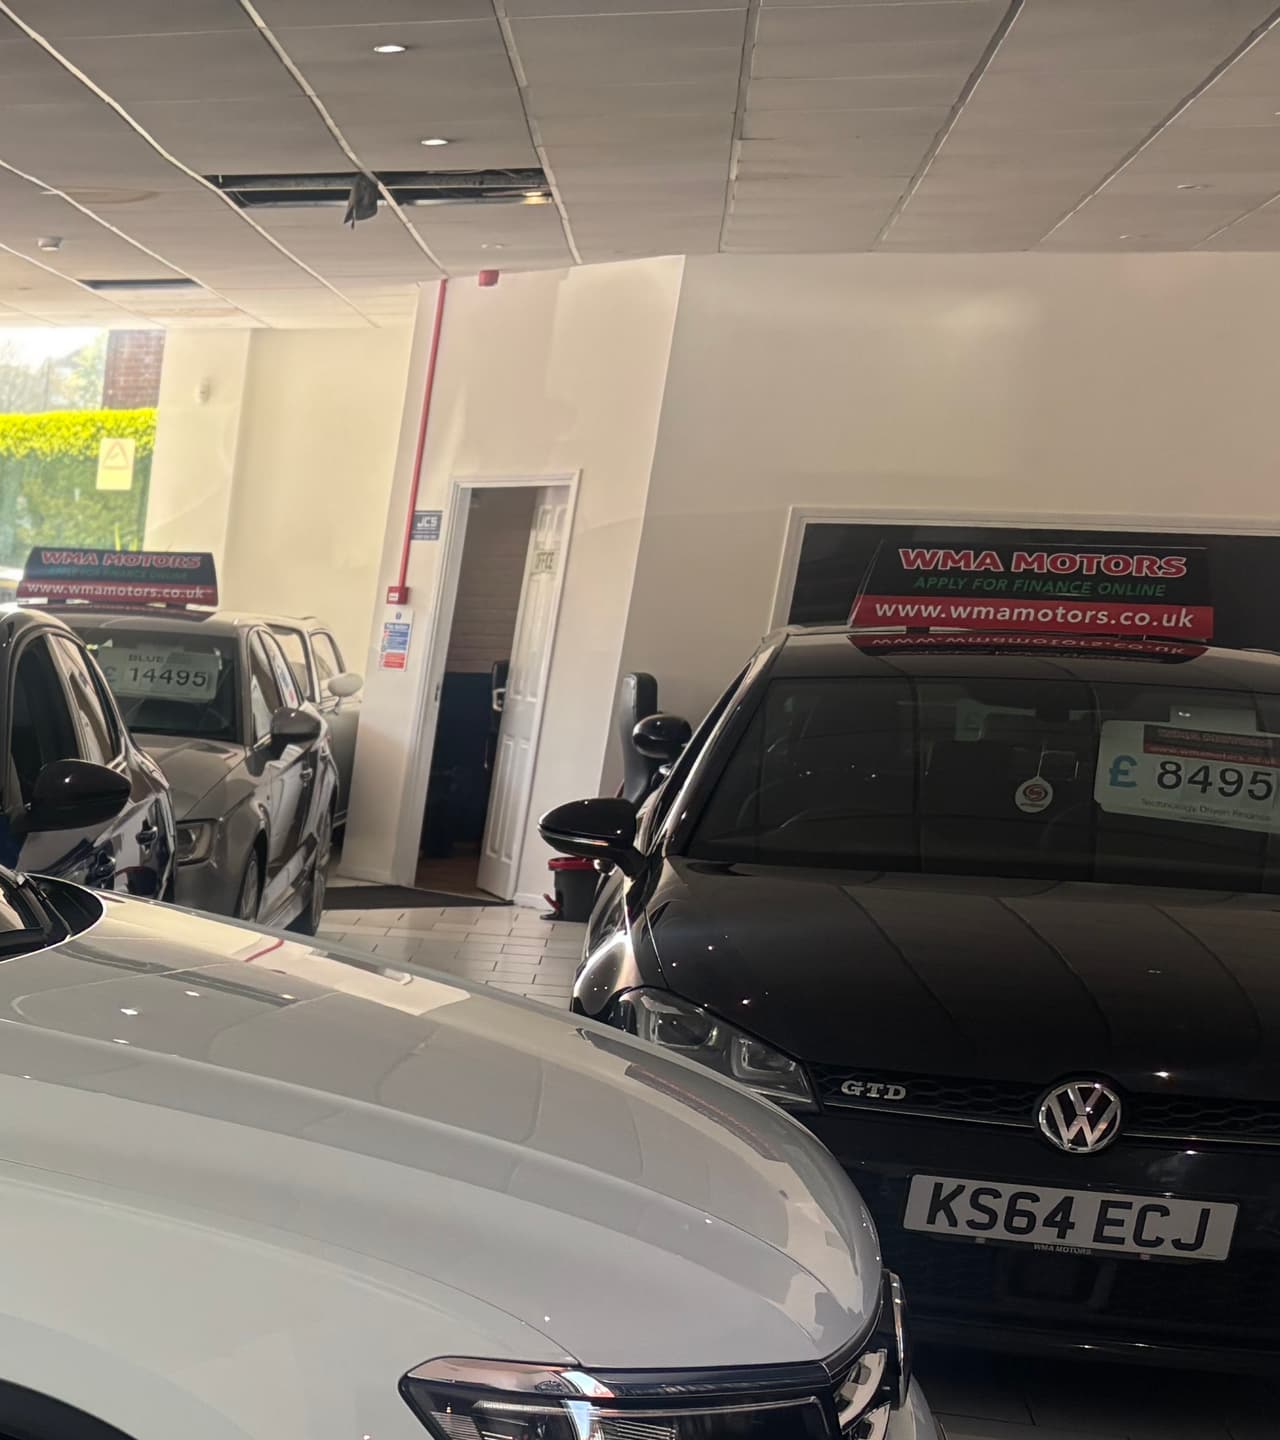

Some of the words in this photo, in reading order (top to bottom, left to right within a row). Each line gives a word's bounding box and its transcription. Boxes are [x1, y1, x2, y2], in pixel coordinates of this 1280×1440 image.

[41, 551, 99, 565] WMA
[103, 553, 201, 569] MOTORS
[899, 548, 1004, 572] WMA
[1011, 552, 1187, 578] MOTORS
[27, 583, 205, 600] www.wmamotors.co.uk
[914, 576, 968, 591] APPLY
[972, 578, 1008, 592] FOR
[1013, 579, 1092, 595] FINANCE
[1097, 582, 1167, 597] ONLINE
[875, 602, 1193, 628] www.wmamotors.co.uk
[128, 667, 208, 688] 14495
[1108, 754, 1138, 788] £
[1156, 760, 1273, 802] 8495
[840, 1080, 907, 1101] GTD
[925, 1182, 1076, 1240] KS64
[1092, 1199, 1212, 1252] ECJ
